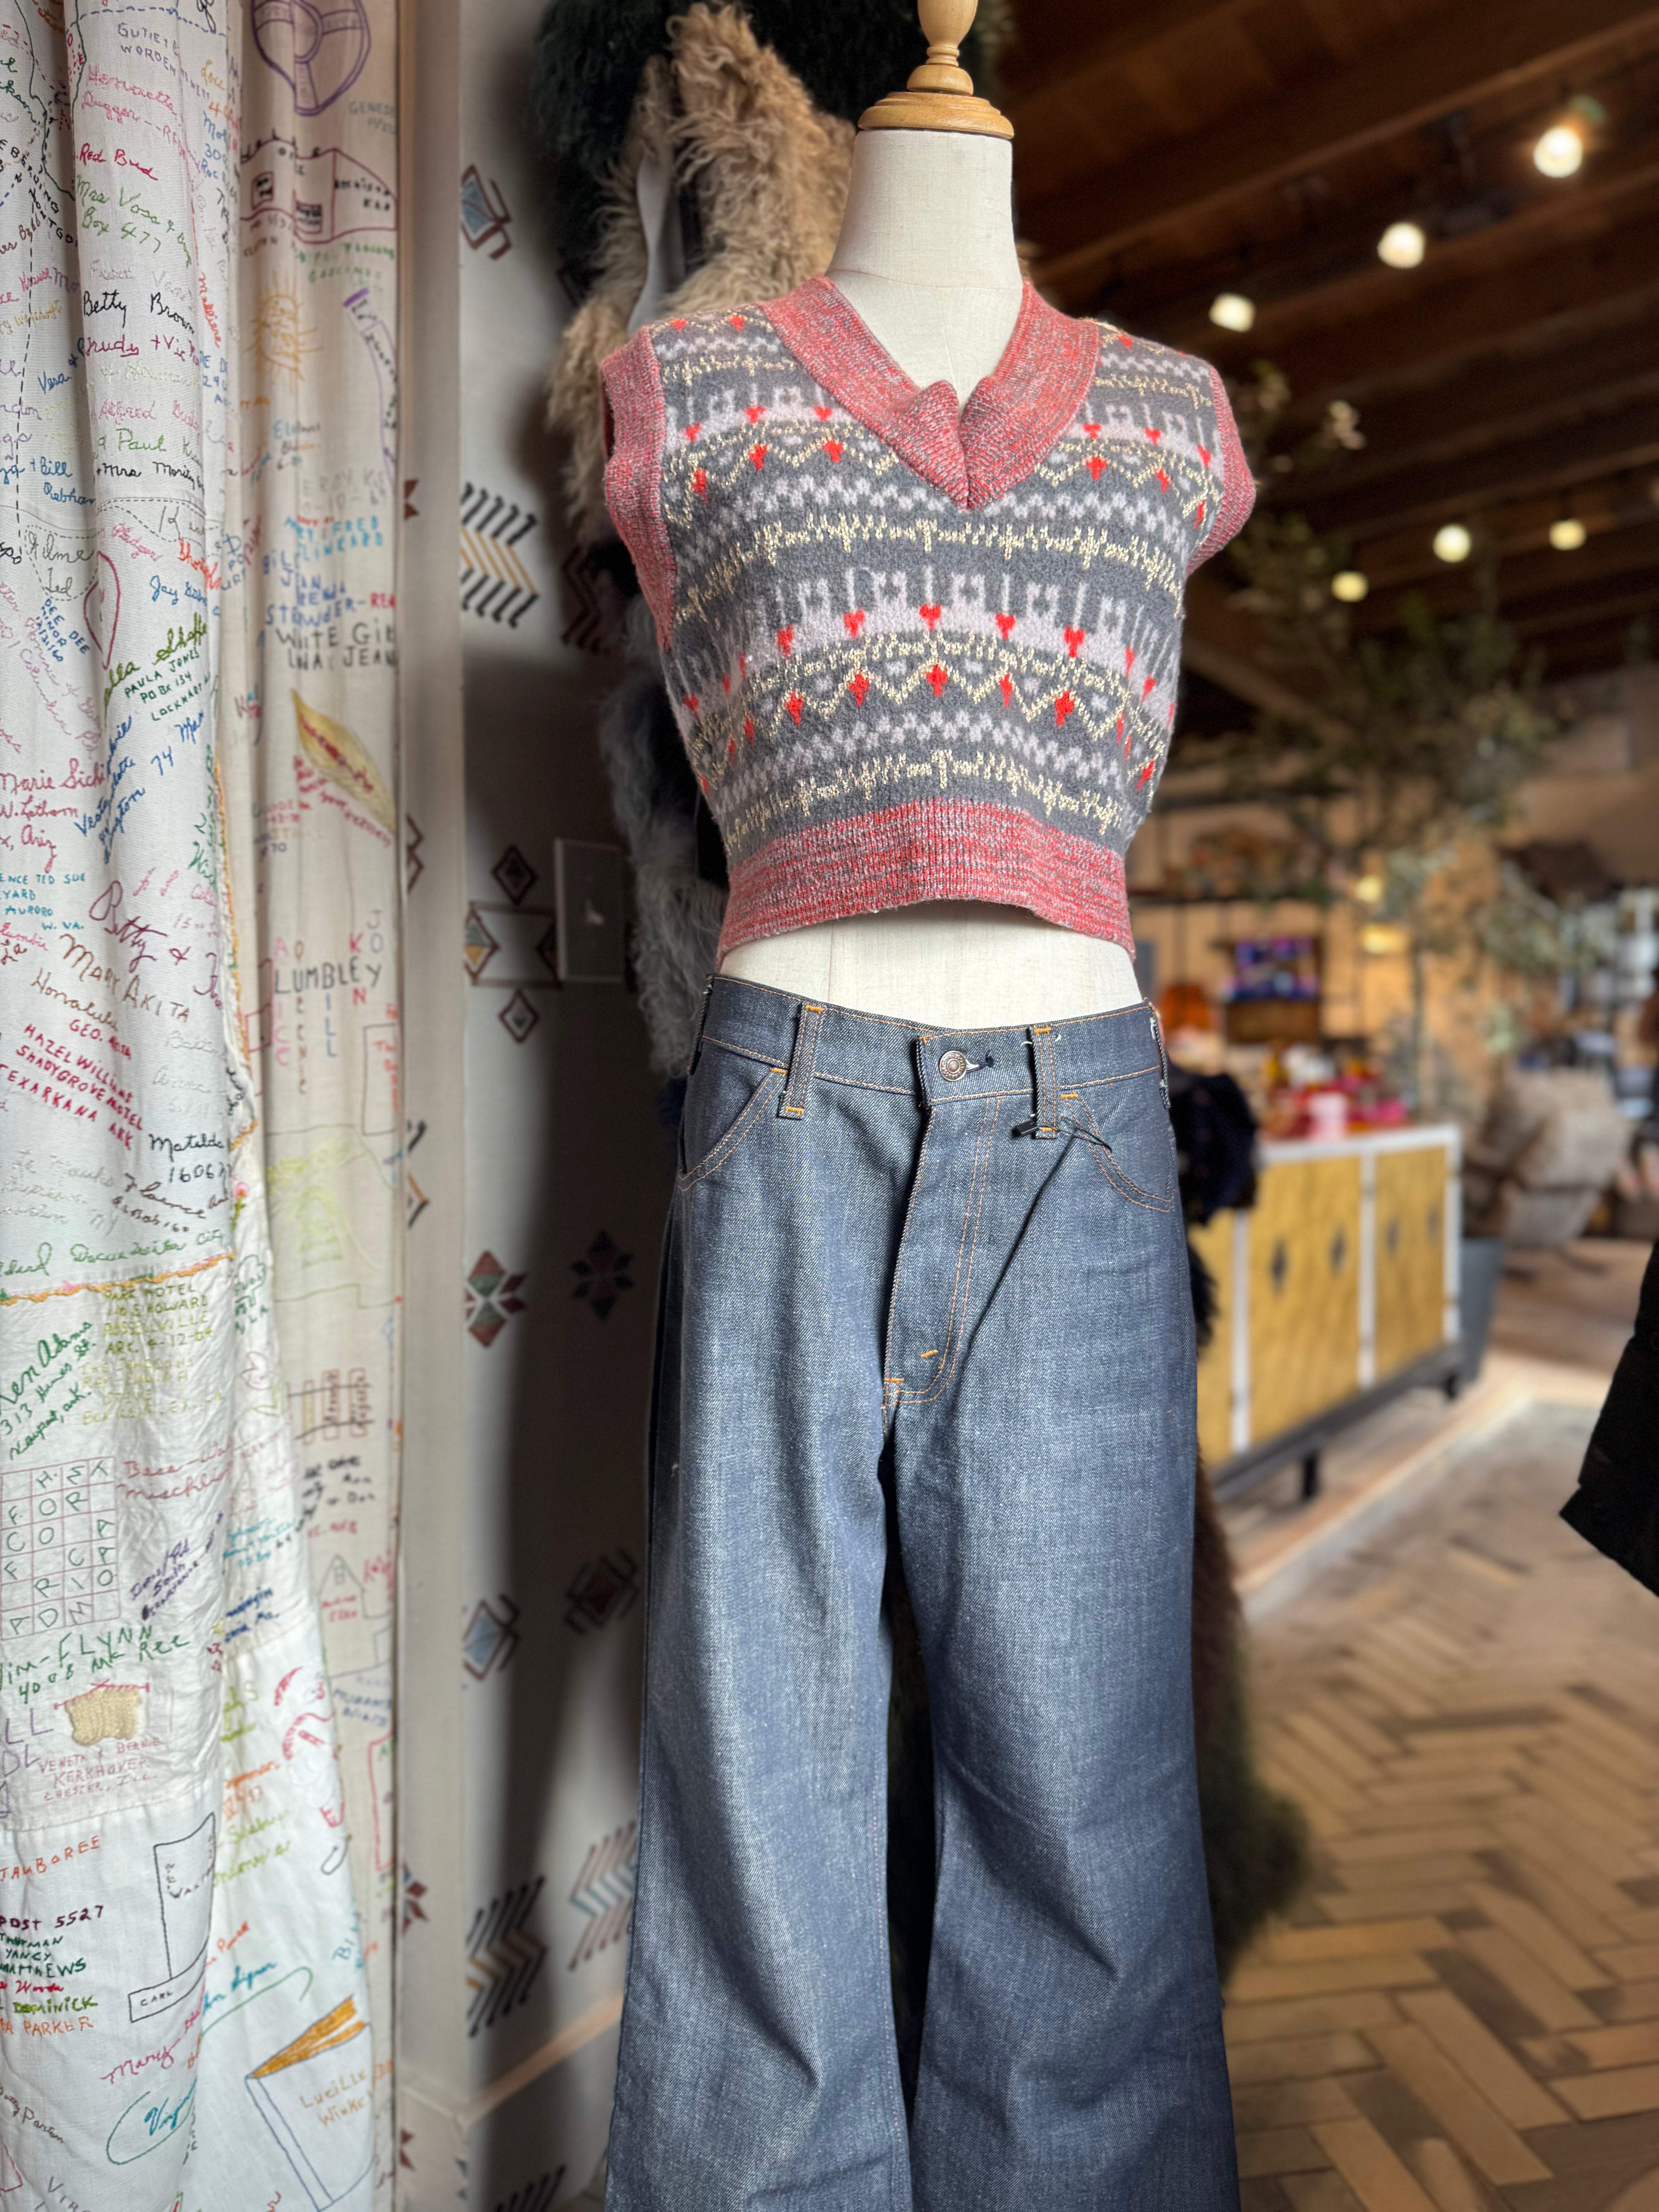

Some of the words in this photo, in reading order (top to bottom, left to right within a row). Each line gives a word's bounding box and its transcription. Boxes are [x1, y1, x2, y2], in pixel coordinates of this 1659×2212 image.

[83, 289, 127, 328] Betty
[150, 291, 195, 334] Brown
[115, 428, 167, 452] Paul
[124, 670, 163, 698] PAULA
[168, 646, 200, 673] JONES
[36, 874, 55, 884] TED
[64, 873, 86, 884] SUE
[275, 956, 382, 994] LUMBLEY
[24, 1023, 72, 1063] HAZEL
[55, 1905, 104, 1929] 5527
[5, 1948, 52, 1961] YANCY
[140, 1990, 173, 2007] CARL
